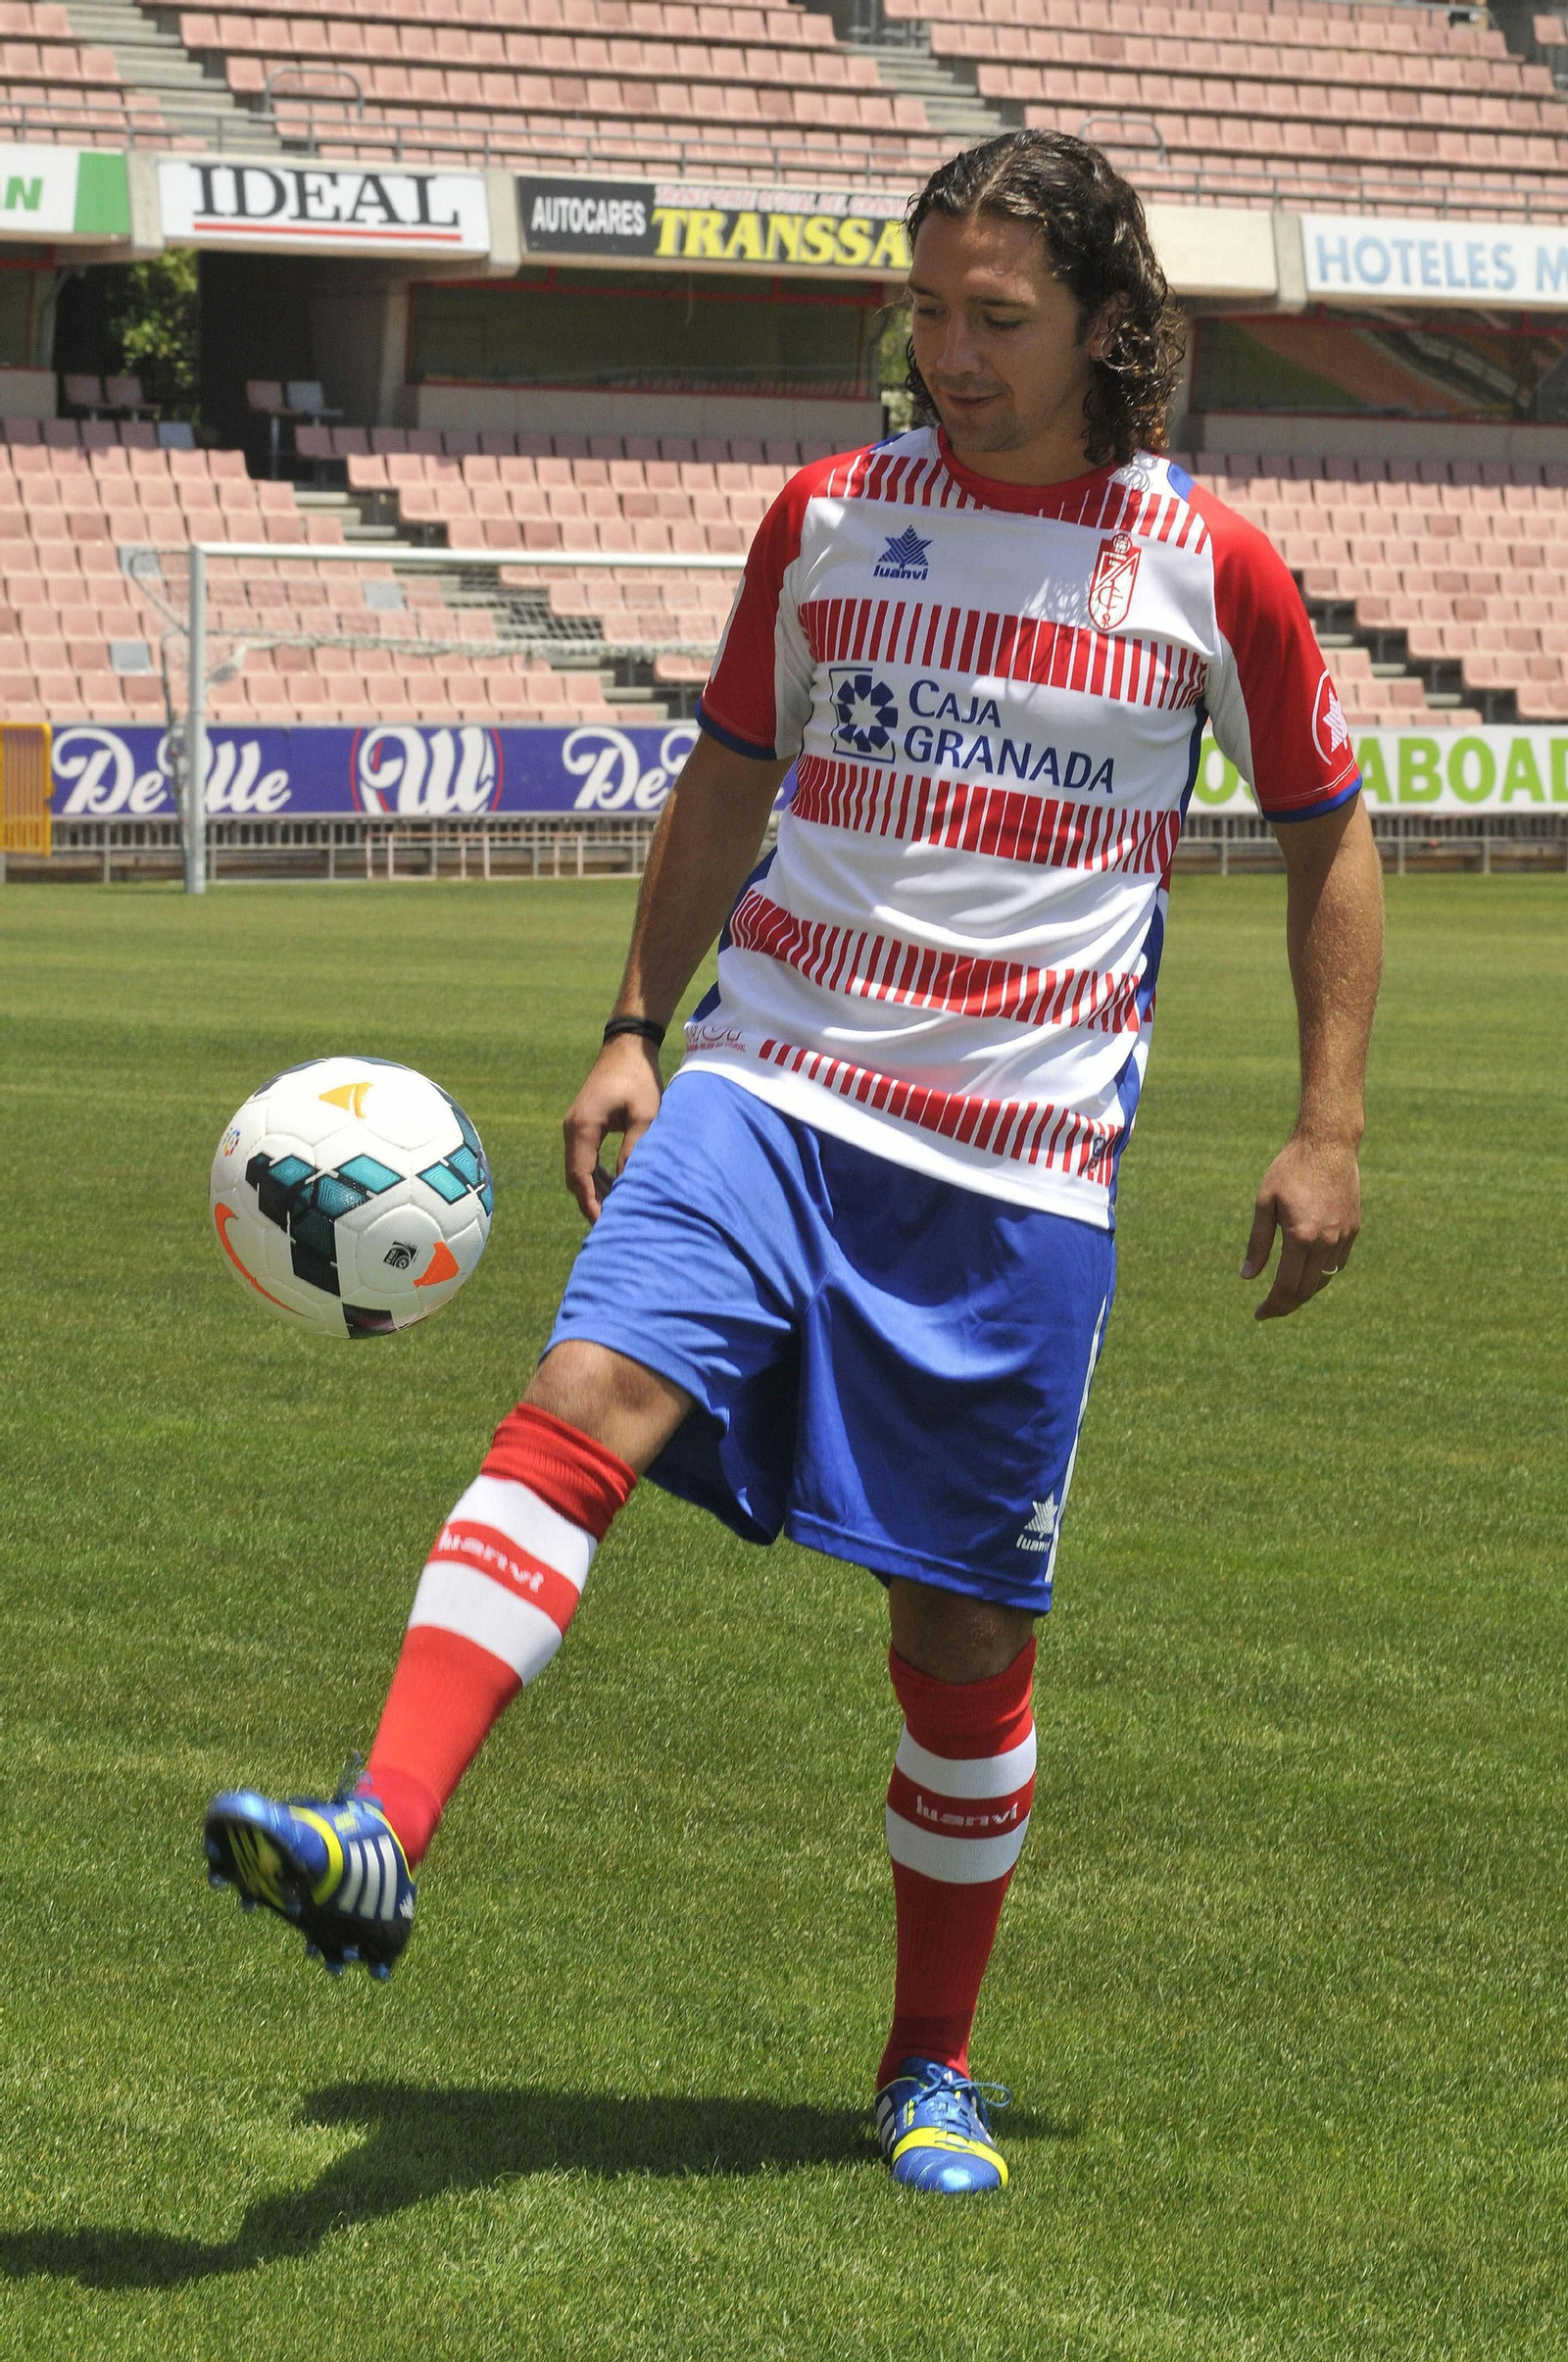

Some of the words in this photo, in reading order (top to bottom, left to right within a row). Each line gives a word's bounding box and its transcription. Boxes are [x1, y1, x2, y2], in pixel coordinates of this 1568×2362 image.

[188, 162, 461, 227] IDEAL
[530, 195, 647, 236] AUTOCARES
[1315, 233, 1517, 291] HOTELES
[872, 564, 930, 581] luanvi
[903, 724, 1116, 795] GRANADA
[915, 1795, 1019, 1827] luanvi
